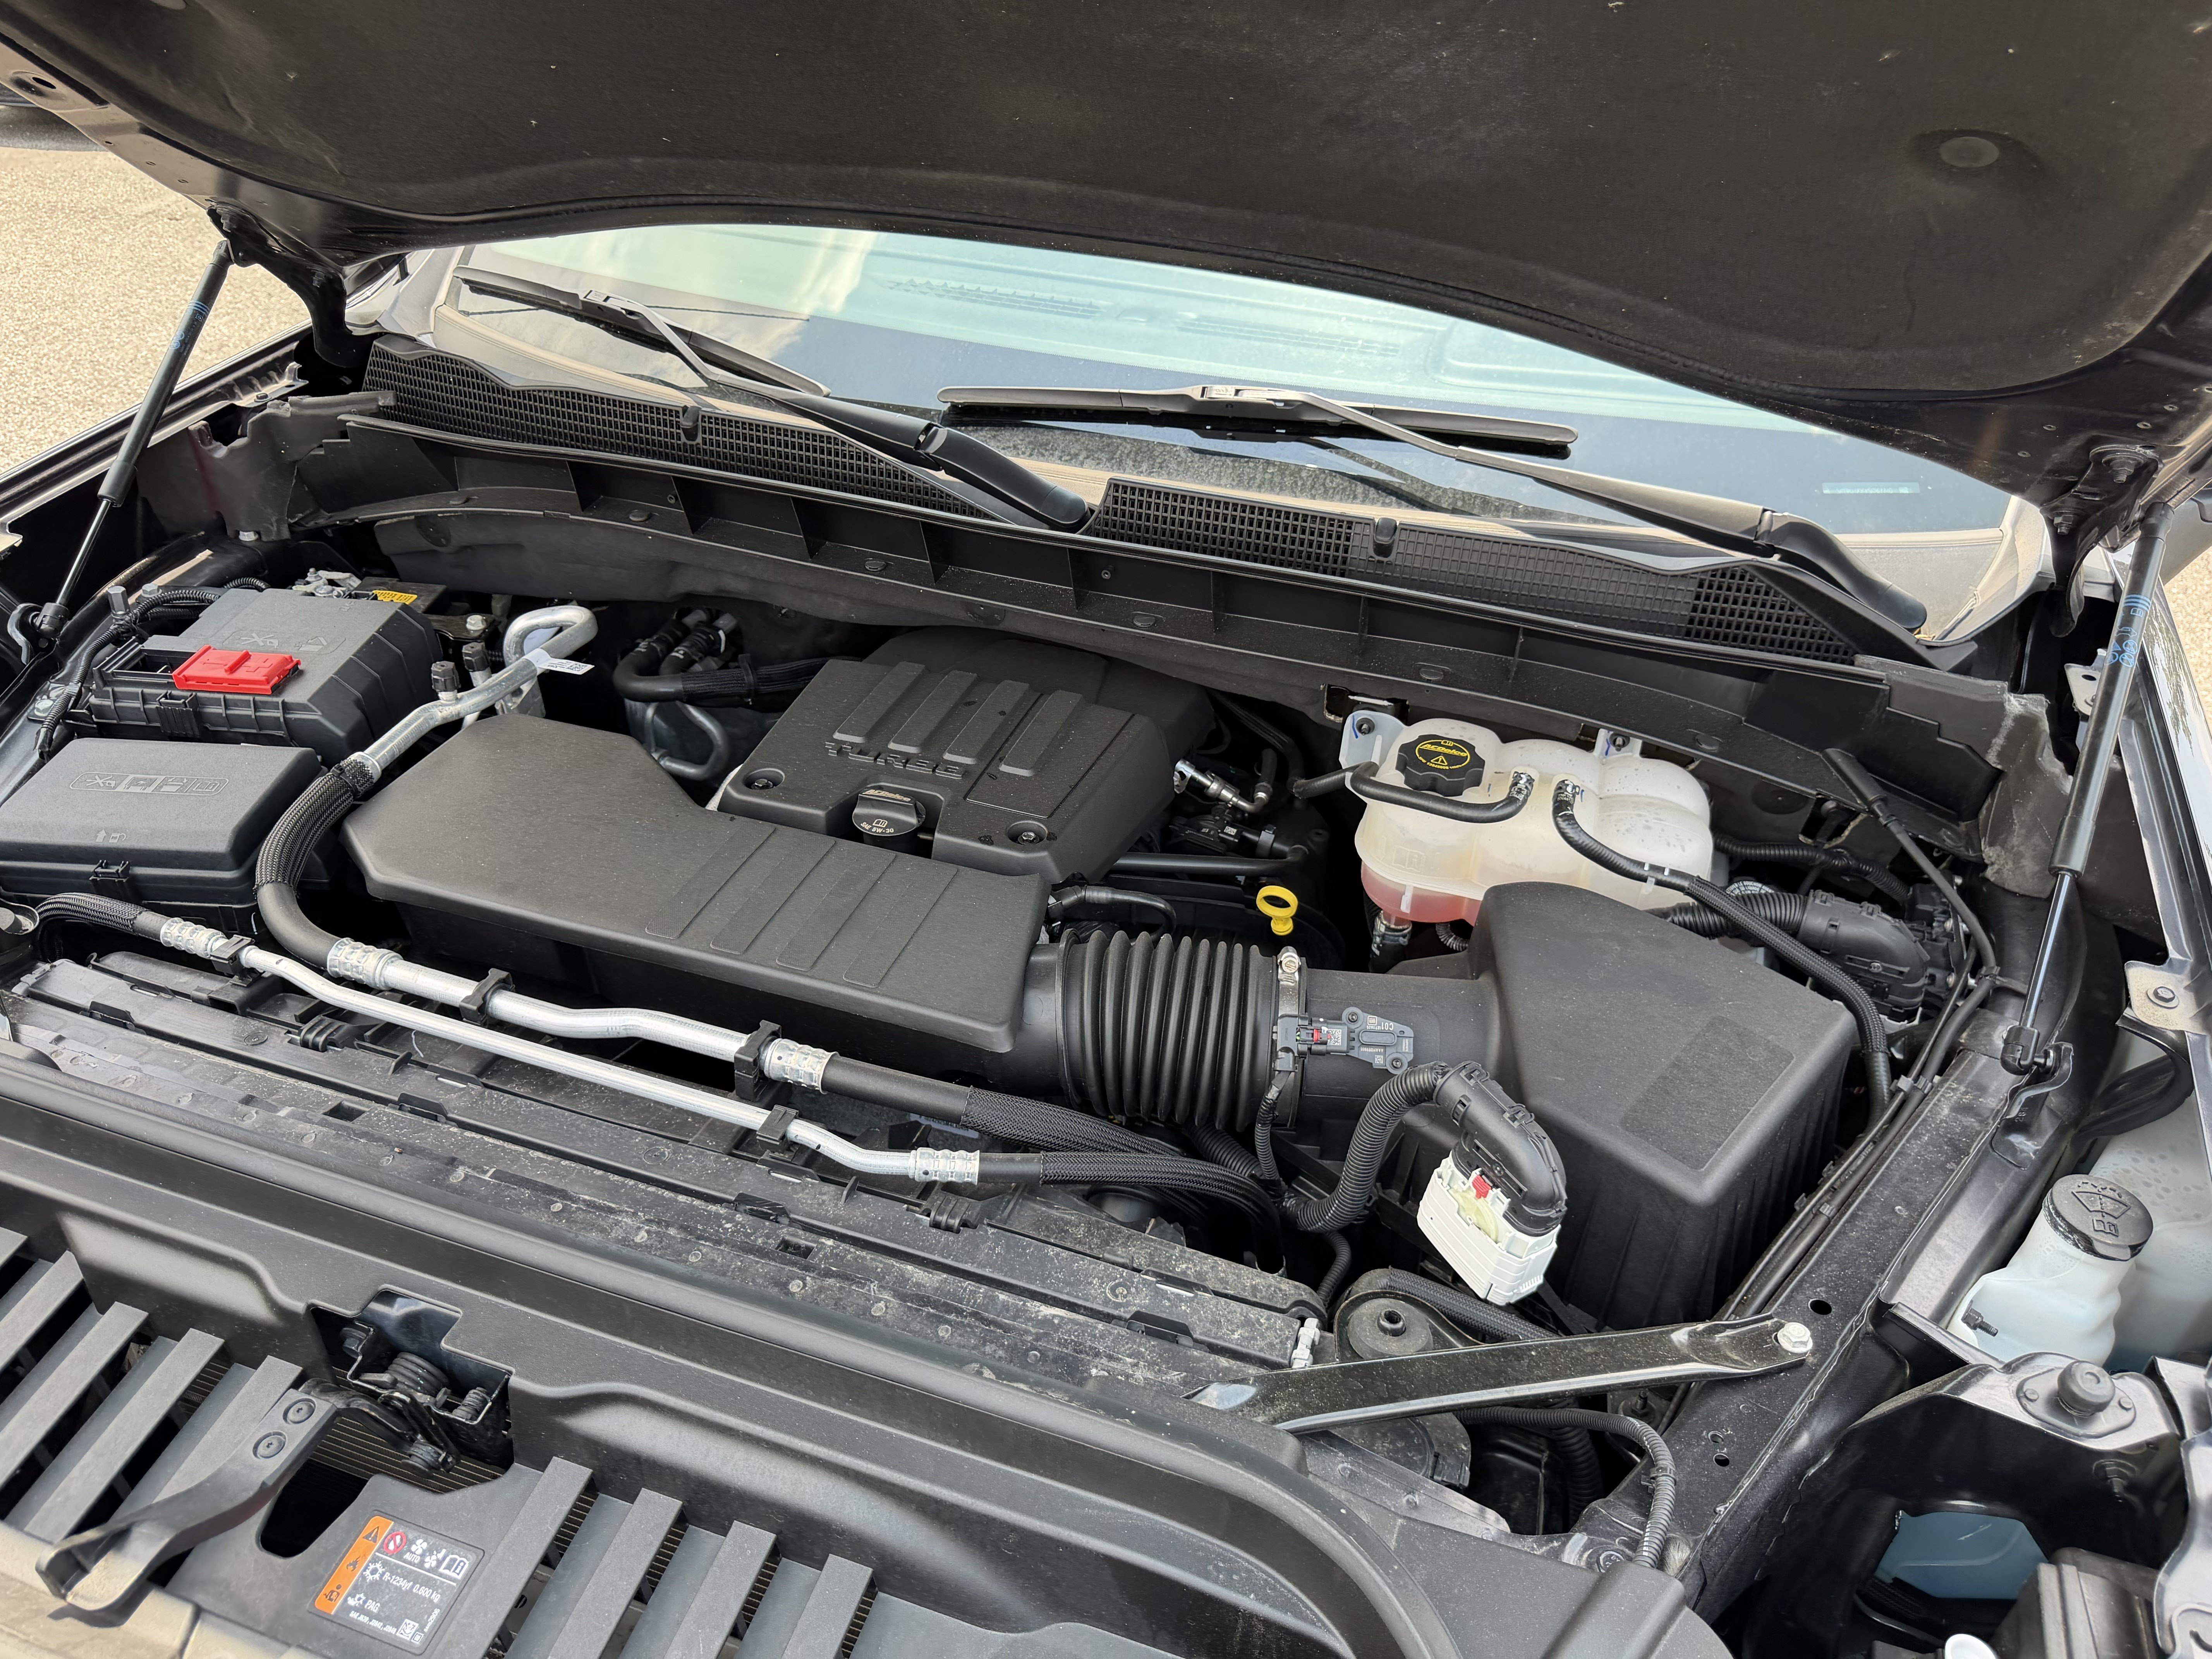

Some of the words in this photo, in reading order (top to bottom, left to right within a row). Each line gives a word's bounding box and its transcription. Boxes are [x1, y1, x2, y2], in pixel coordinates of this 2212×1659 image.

[1422, 744, 1467, 756] ACDelco
[825, 741, 966, 780] TURBO
[864, 789, 911, 801] ACDelco
[860, 822, 872, 830] SAE
[1381, 1022, 1394, 1030] C01
[404, 1552, 420, 1563] AUTO
[382, 1571, 413, 1590] R-1234yf
[412, 1584, 432, 1598] 0.600
[430, 1590, 441, 1603] kg
[364, 1599, 380, 1613] PAG
